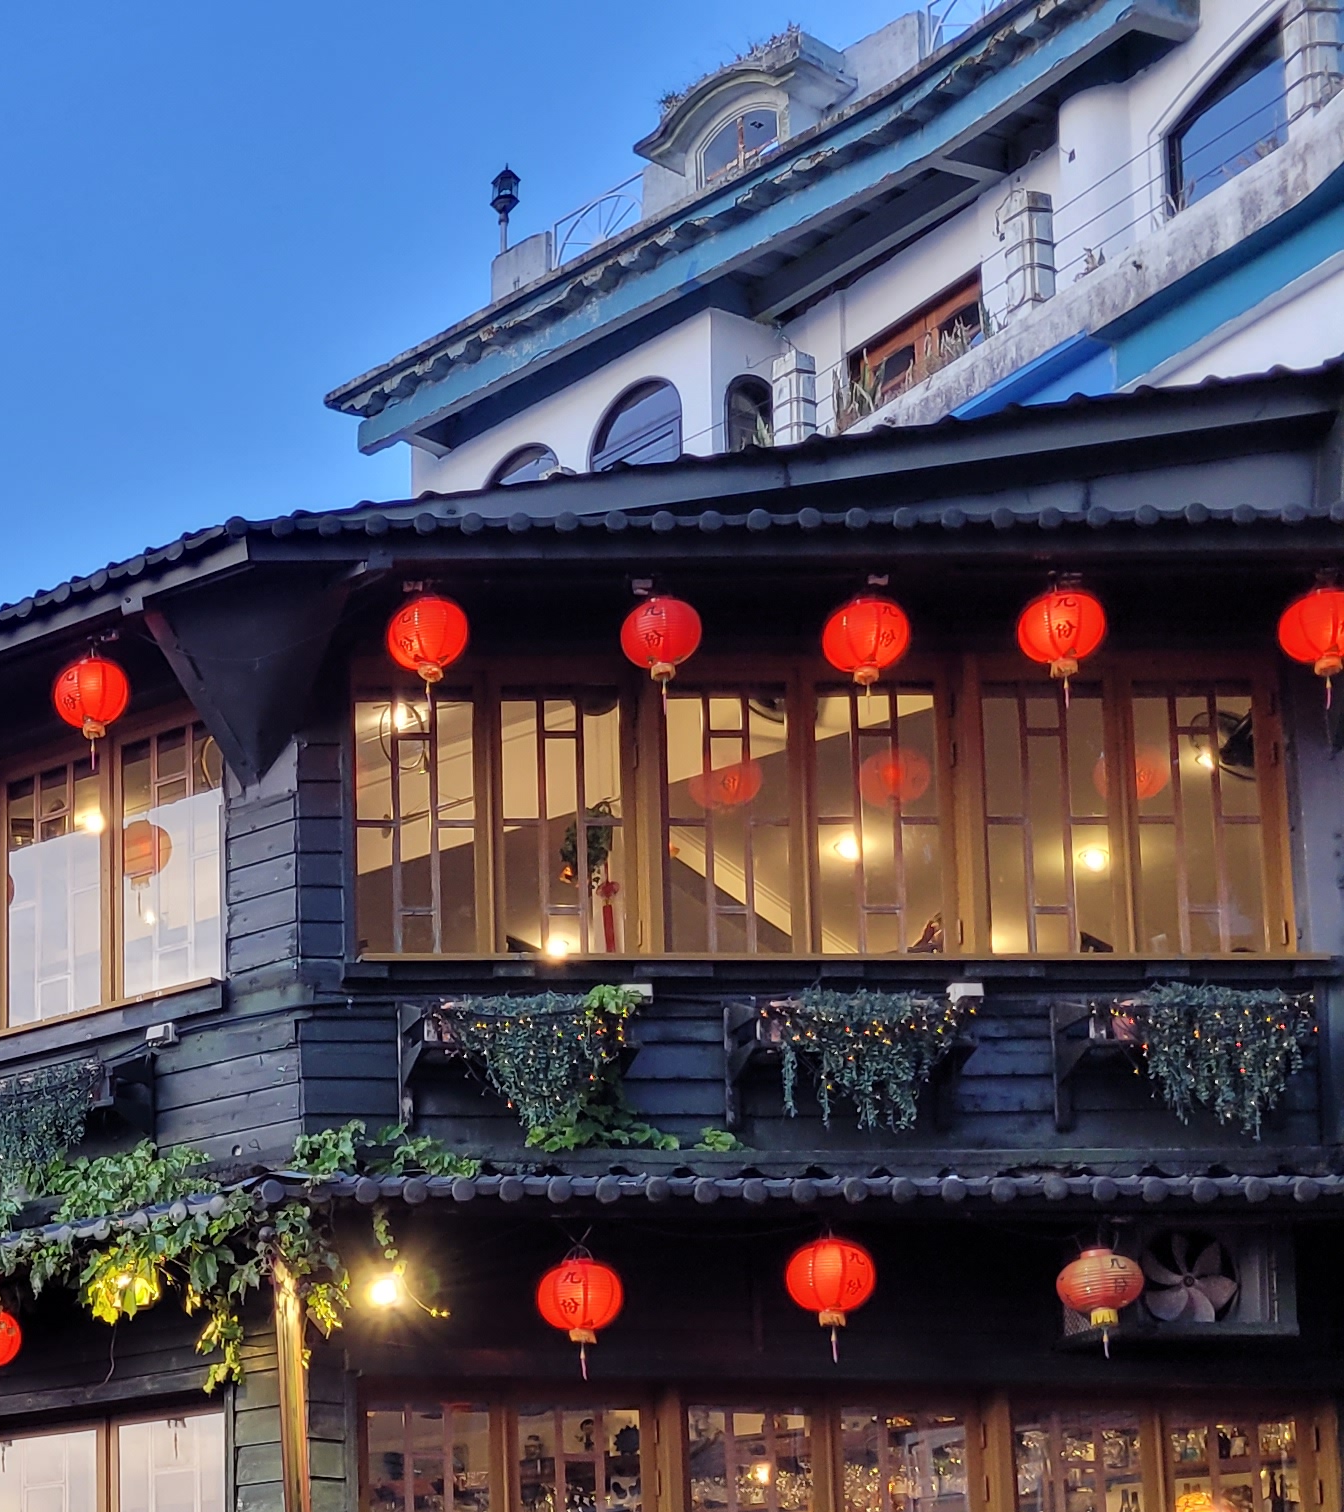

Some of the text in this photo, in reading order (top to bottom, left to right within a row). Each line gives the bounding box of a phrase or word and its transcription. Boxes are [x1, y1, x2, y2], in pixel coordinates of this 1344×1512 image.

[1054, 596, 1076, 638] 九份
[561, 1271, 579, 1314] 九份
[846, 1252, 866, 1295] 九份
